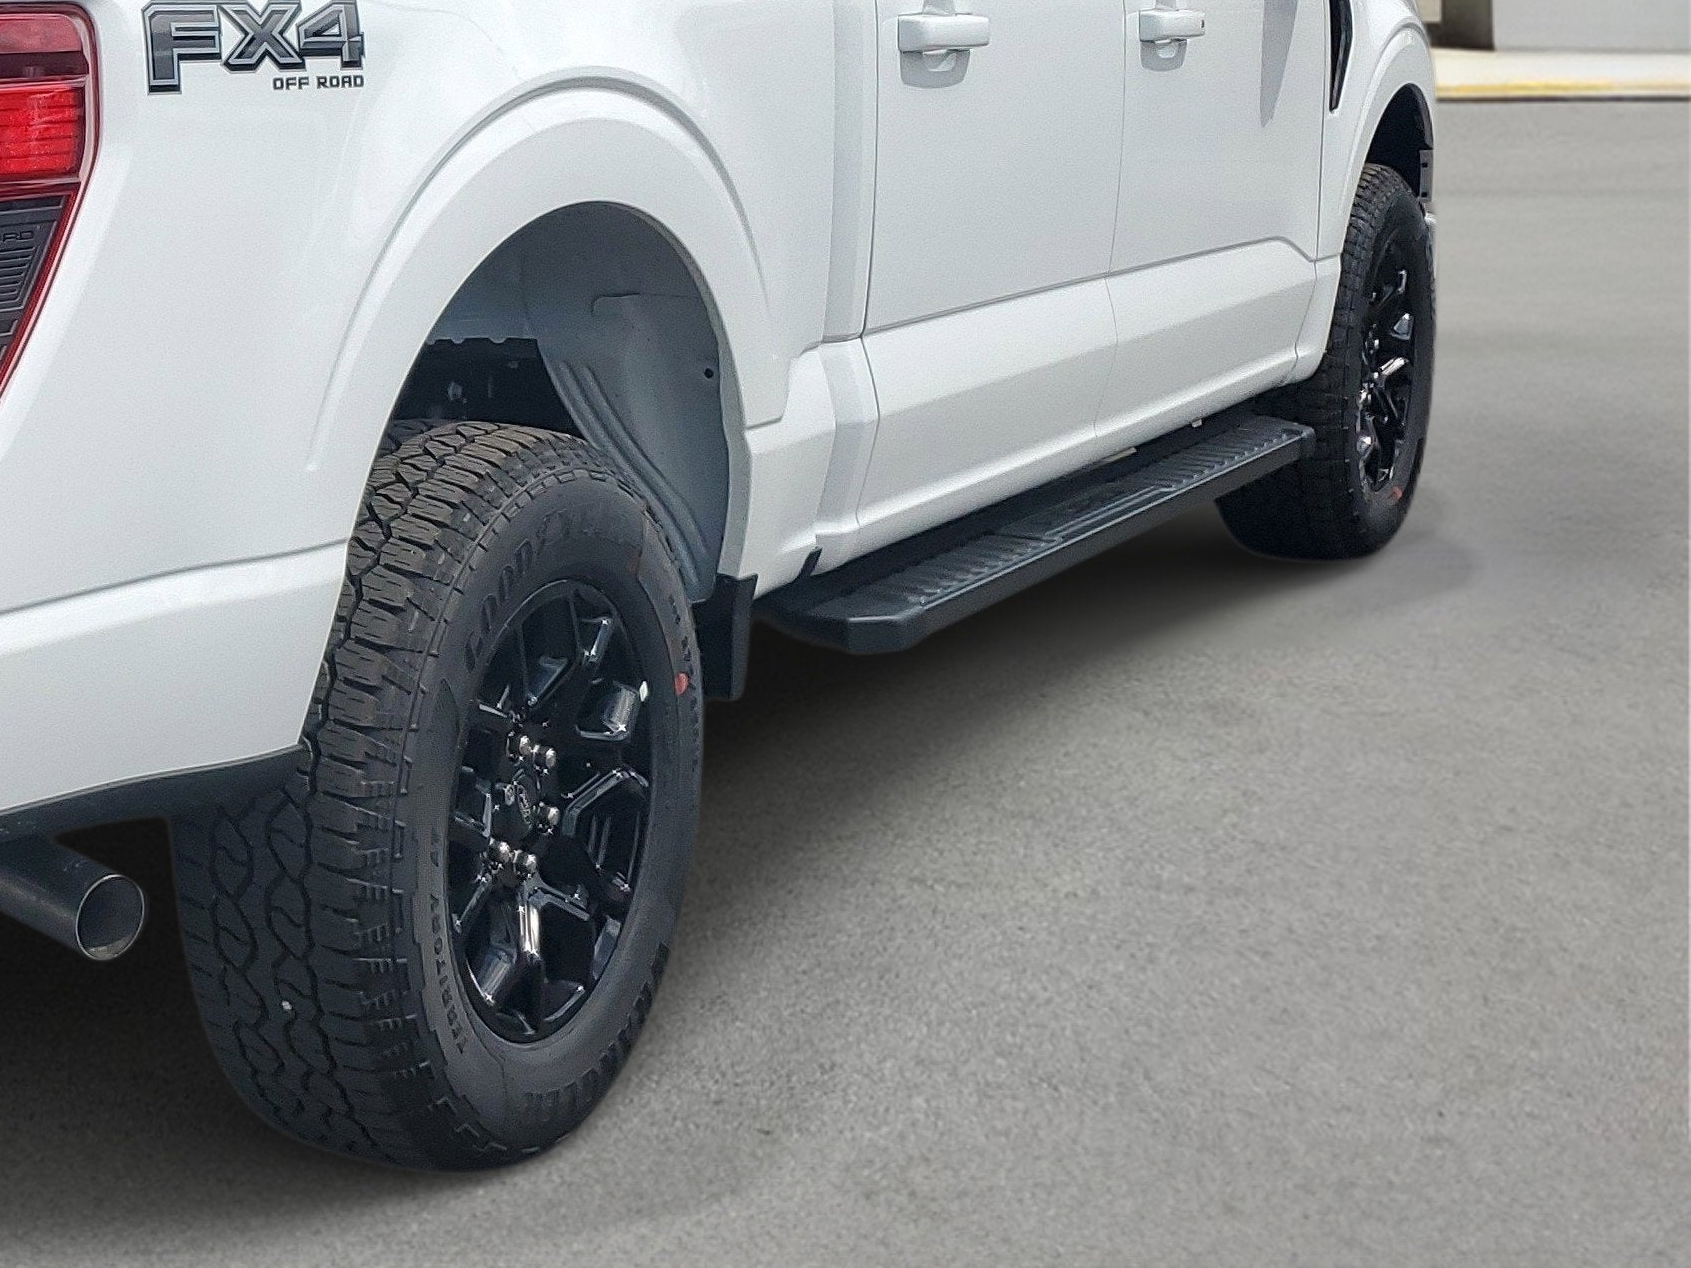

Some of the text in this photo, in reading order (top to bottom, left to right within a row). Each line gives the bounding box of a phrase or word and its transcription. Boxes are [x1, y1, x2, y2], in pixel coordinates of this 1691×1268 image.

[141, 0, 366, 95] FX4
[273, 74, 365, 90] OFF ROAD
